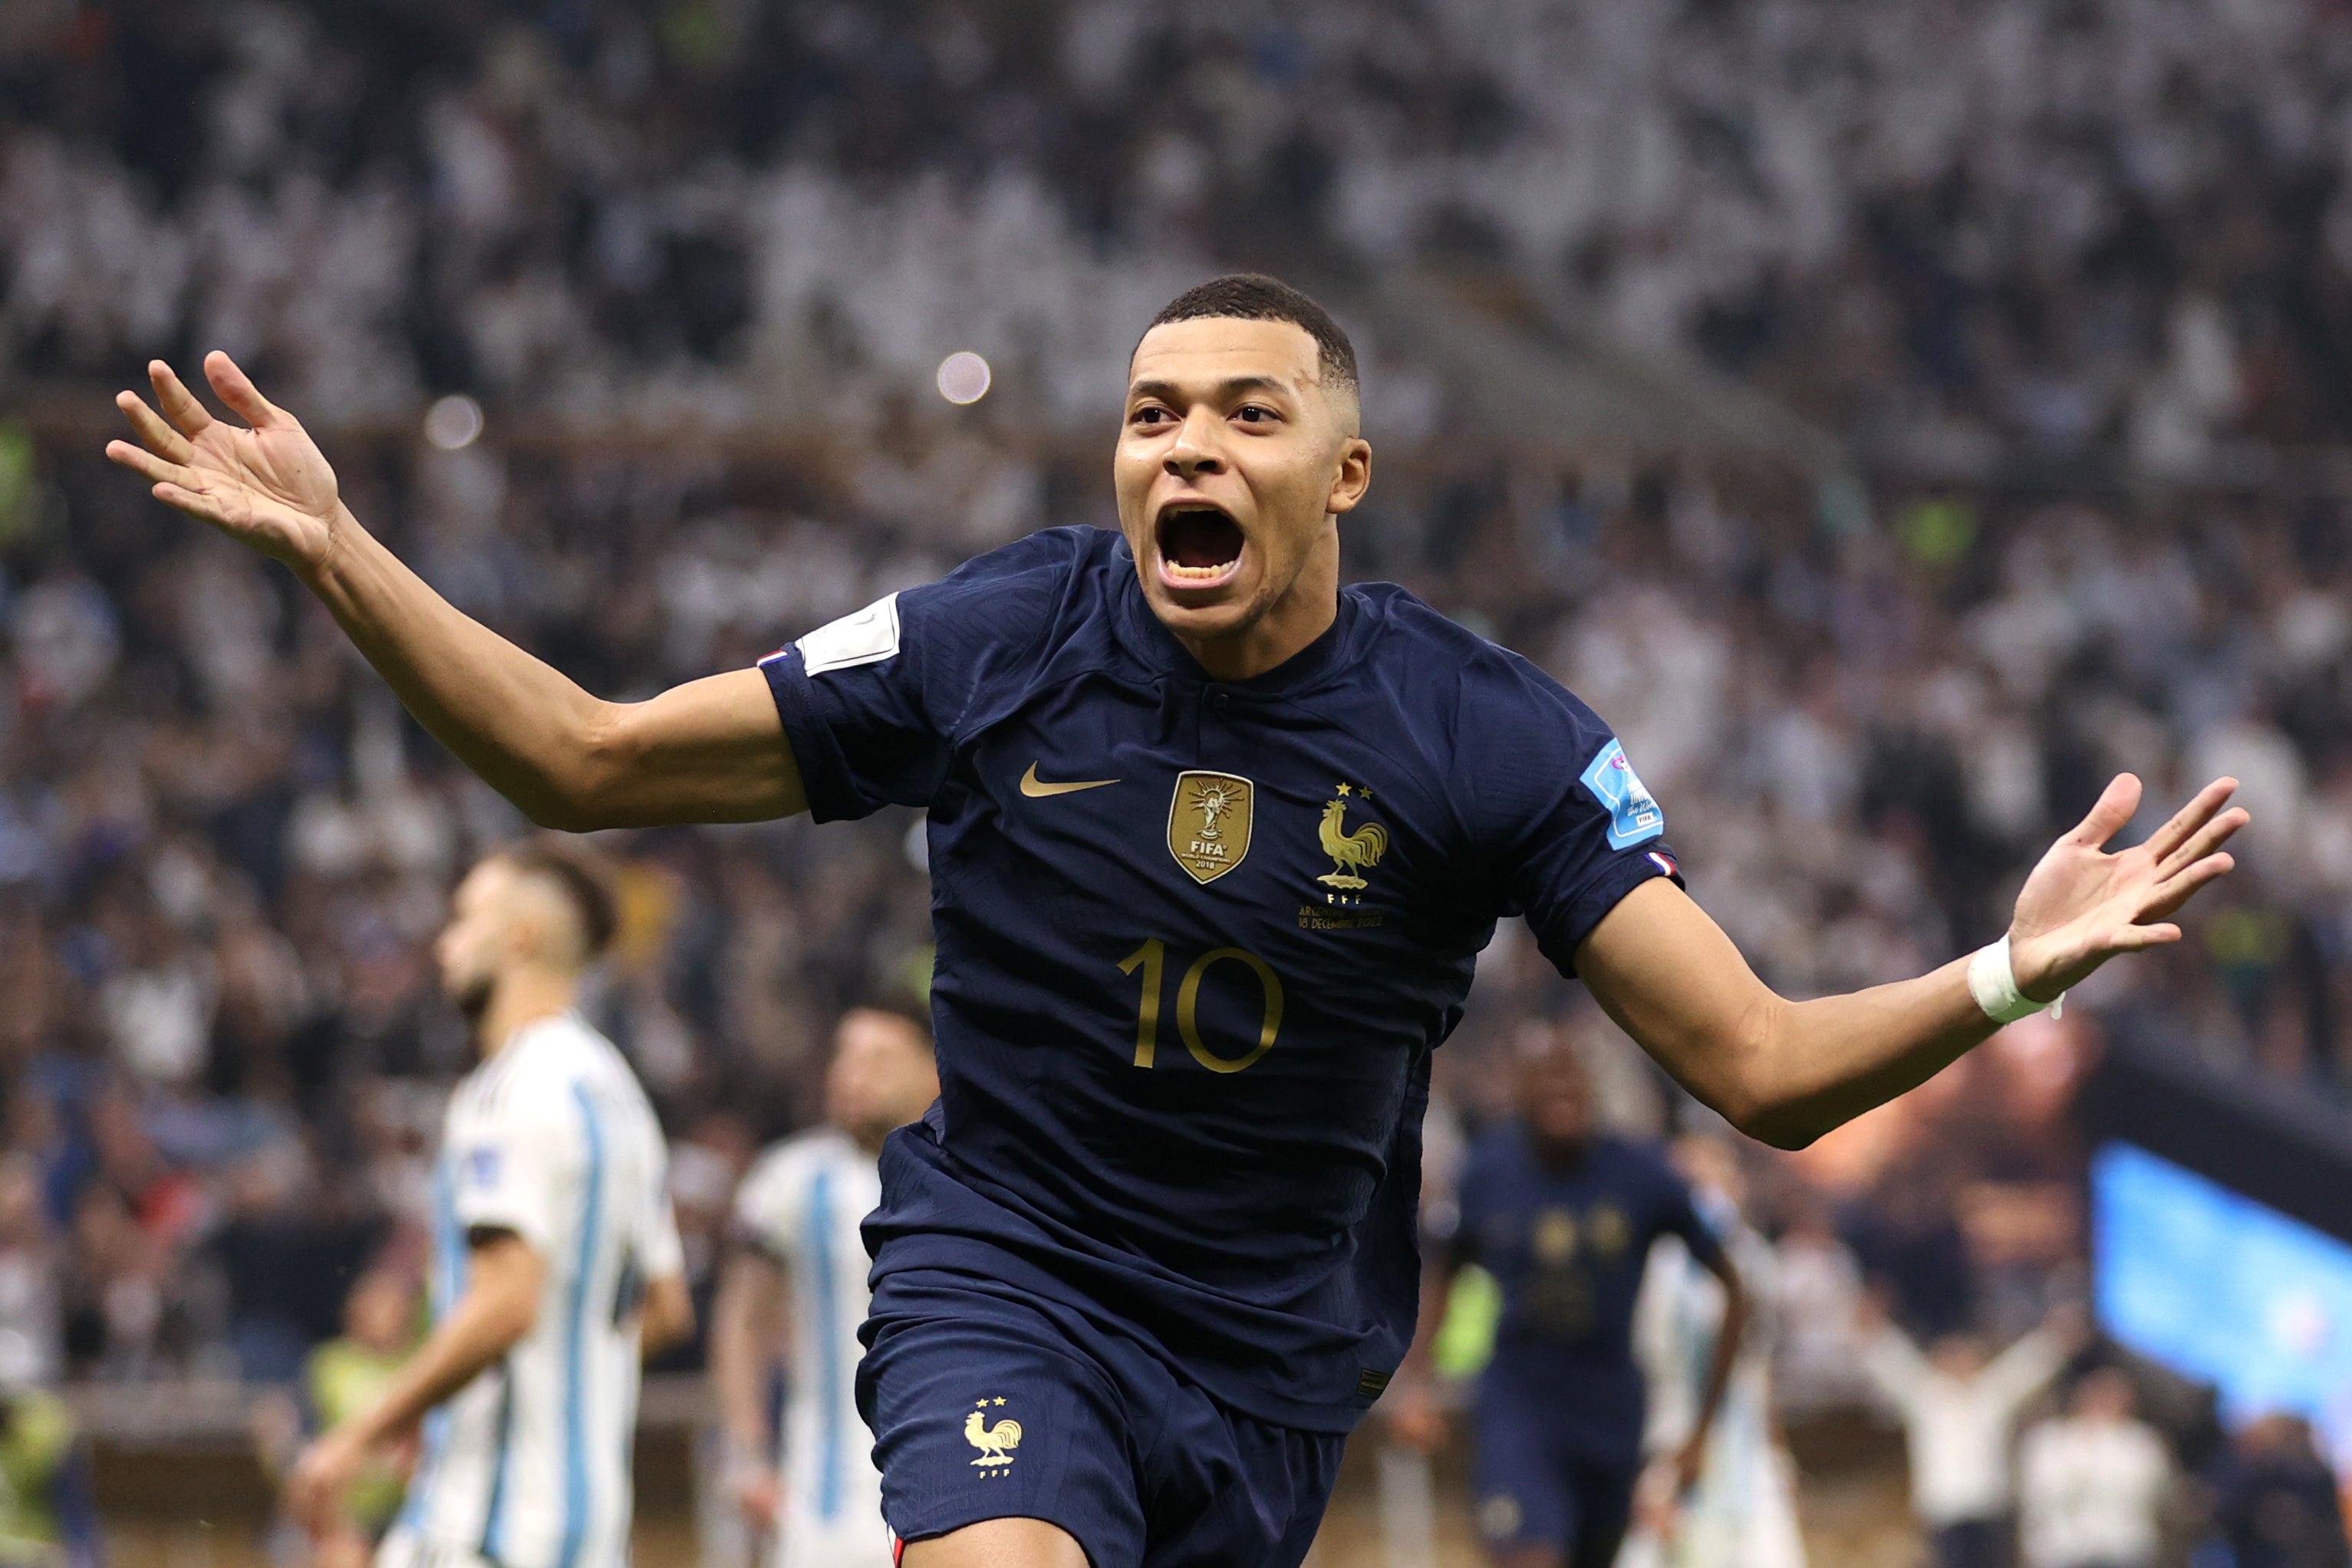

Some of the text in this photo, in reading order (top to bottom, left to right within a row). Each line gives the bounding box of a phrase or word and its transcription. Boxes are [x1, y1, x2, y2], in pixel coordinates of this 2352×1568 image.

[1639, 815, 1652, 823] FIFA
[1191, 840, 1224, 856] FIFA
[1196, 860, 1215, 869] 2018
[1299, 917, 1309, 928] 18
[1116, 937, 1284, 1074] 10
